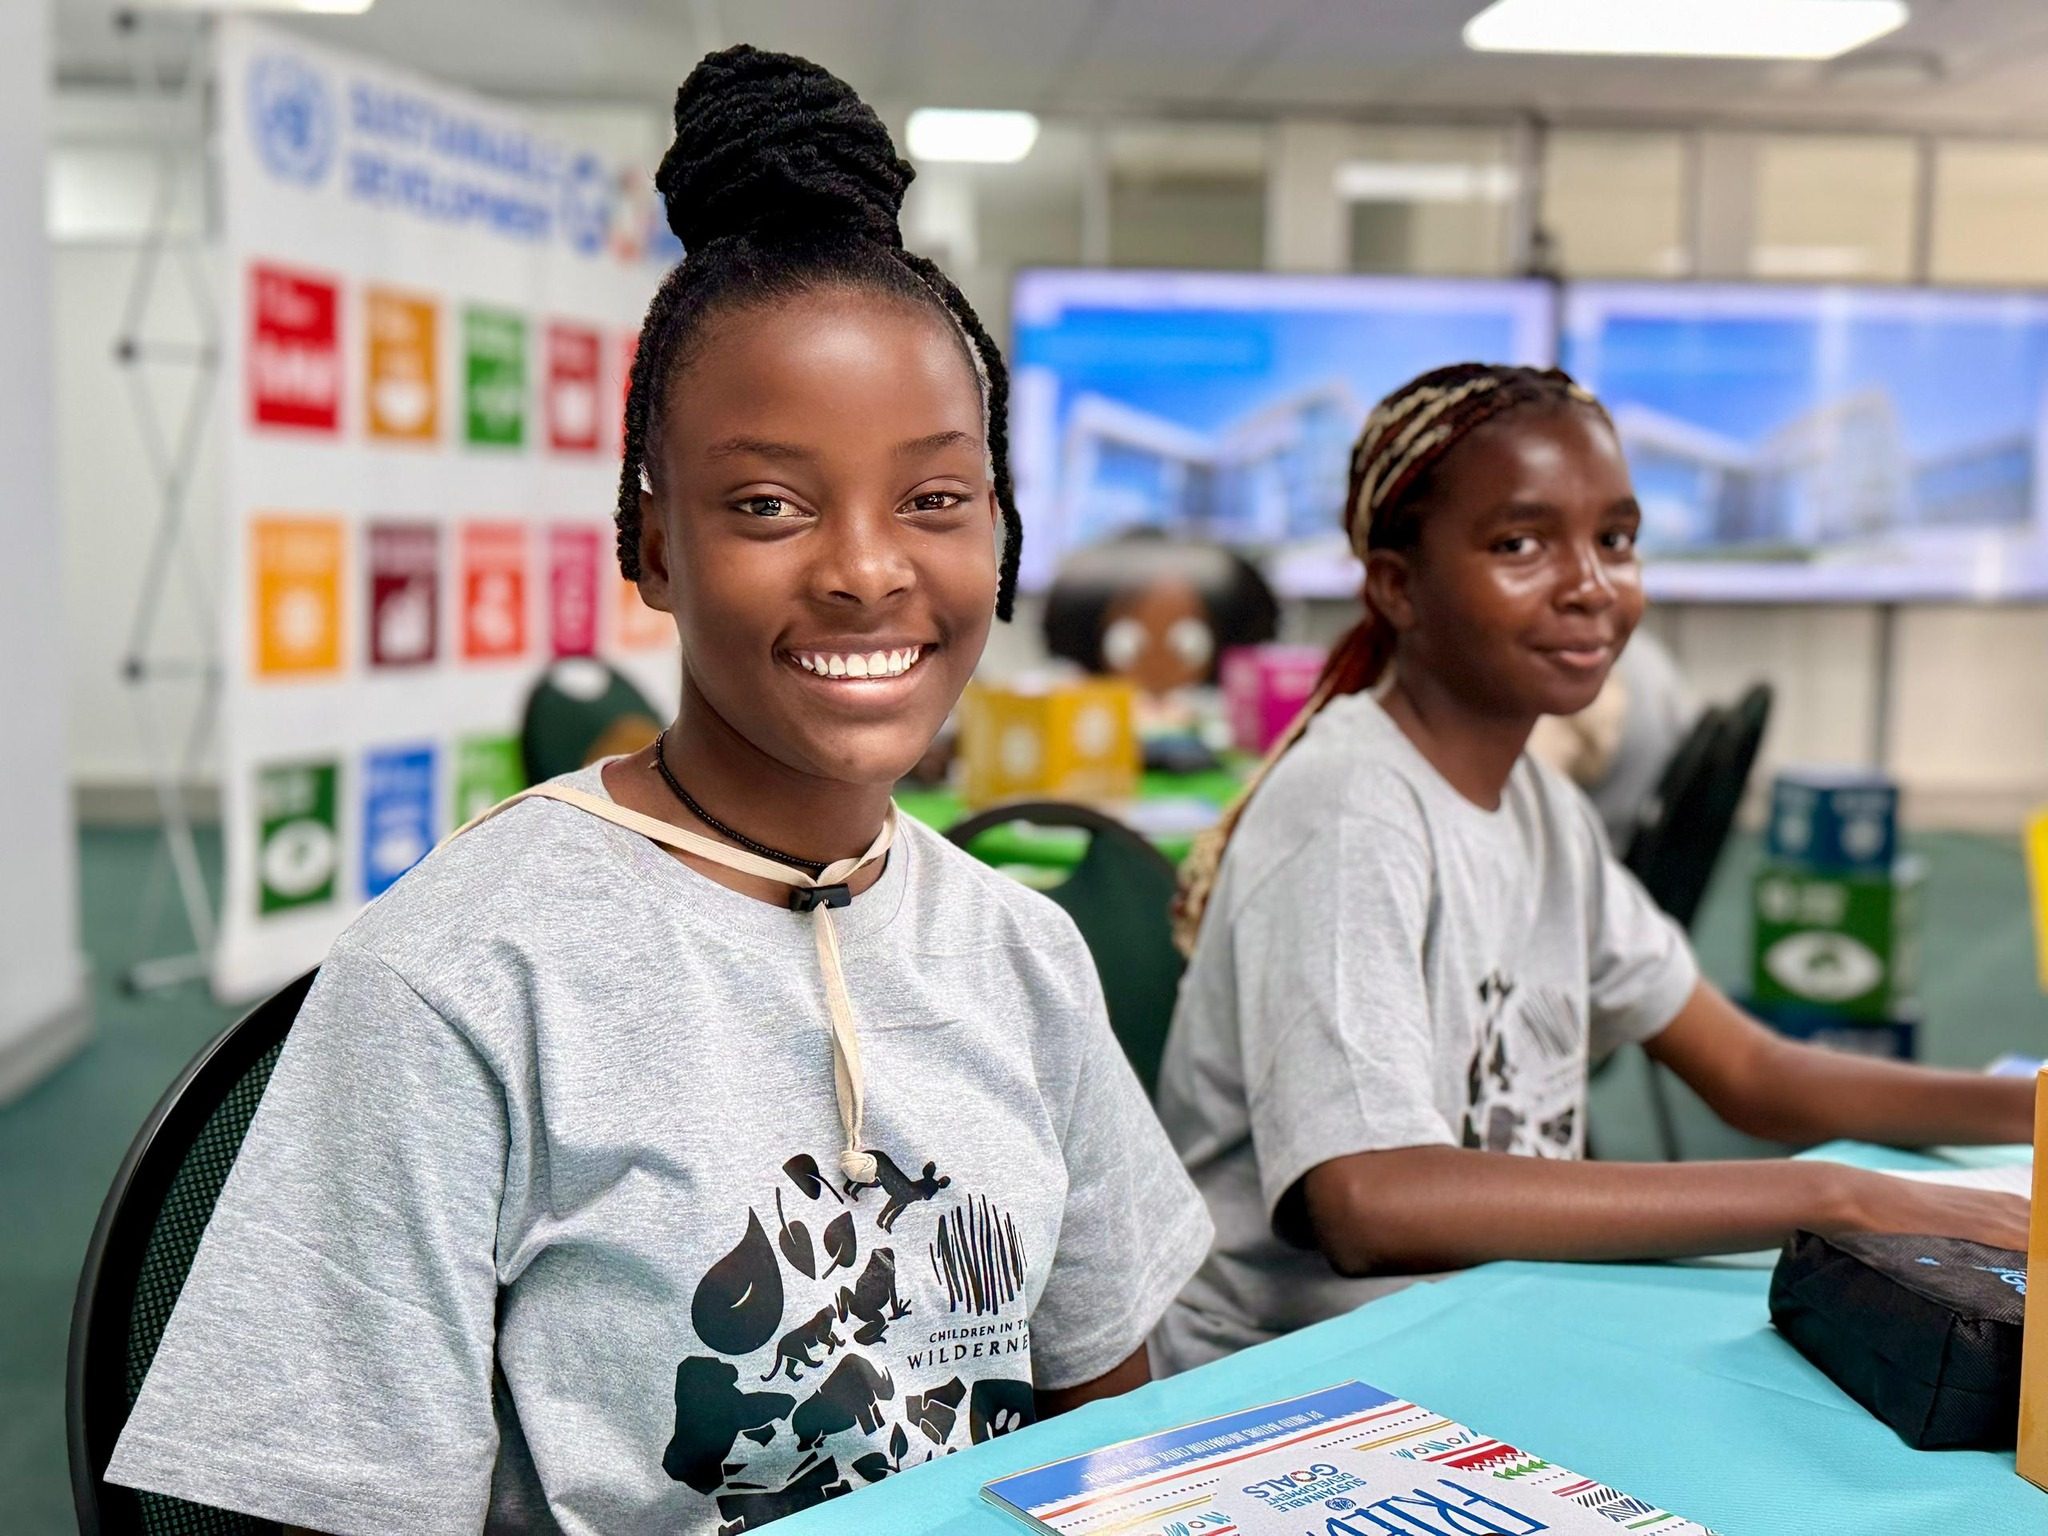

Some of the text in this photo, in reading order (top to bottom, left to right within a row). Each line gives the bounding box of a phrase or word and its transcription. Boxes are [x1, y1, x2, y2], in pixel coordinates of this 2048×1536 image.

[929, 1324, 995, 1343] CHILDREN
[1000, 1322, 1013, 1334] IN
[907, 1333, 1028, 1370] WILDERNE
[1242, 1463, 1339, 1499] GOALS
[1264, 1472, 1355, 1506] DEVELOPMENT
[1274, 1477, 1367, 1512] SUSTAINABLE
